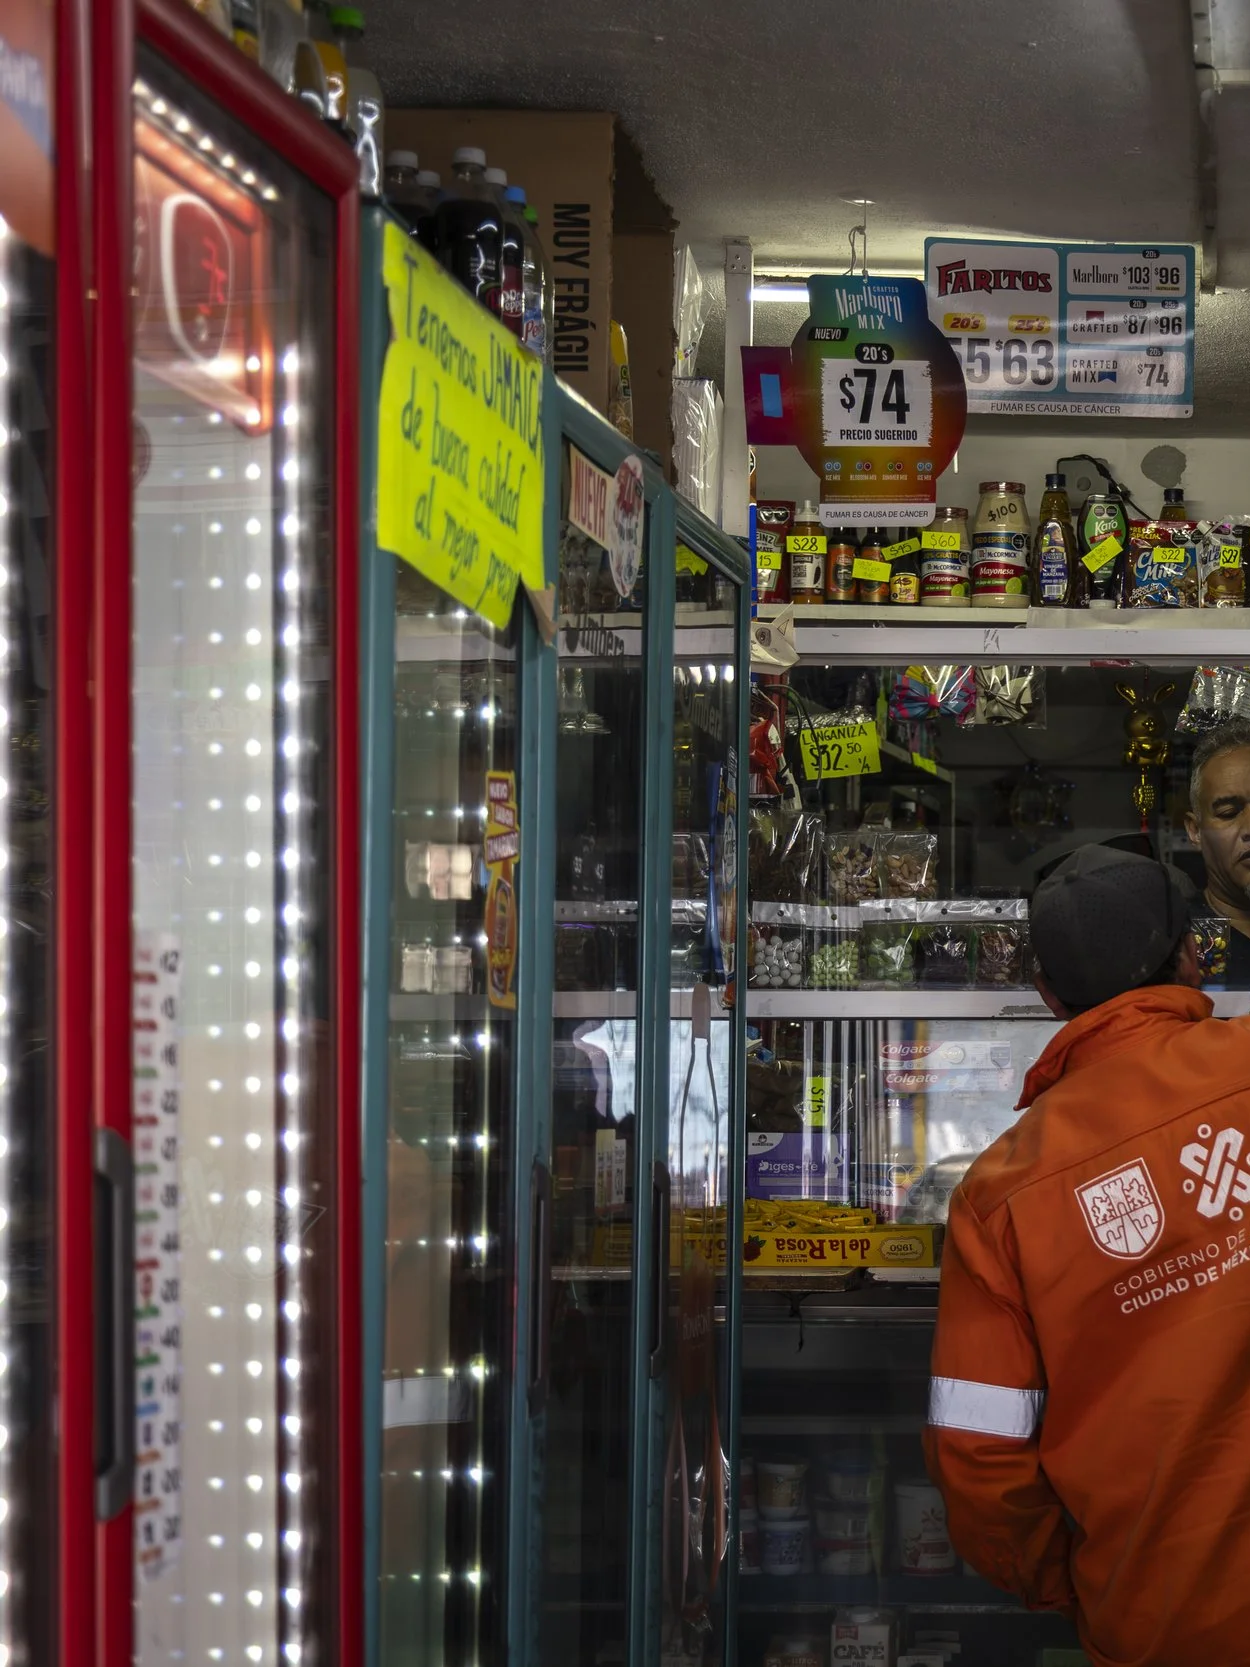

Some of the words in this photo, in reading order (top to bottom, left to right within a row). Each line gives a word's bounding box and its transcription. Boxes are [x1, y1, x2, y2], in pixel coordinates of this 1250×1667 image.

[553, 203, 591, 267] MUY
[936, 259, 1053, 298] FARITOS
[1072, 264, 1119, 284] Marlboro
[1122, 266, 1150, 284] $103
[1154, 266, 1180, 285] $96
[872, 285, 899, 293] CRAFTED
[835, 286, 904, 323] Marlboro
[402, 252, 478, 396] Tenemos
[553, 276, 594, 375] FRÁGIL
[857, 314, 886, 330] MIX
[1072, 323, 1119, 334] CRAFTED
[1123, 314, 1147, 335] $87
[1154, 316, 1182, 336] $96
[814, 327, 842, 341] NUEVO
[995, 338, 1054, 386] $63
[1072, 359, 1118, 370] CRAFTED
[1072, 371, 1098, 384] MIX
[1137, 363, 1170, 387] $74
[839, 368, 911, 425] $74
[990, 402, 1023, 412] FUMAR
[1025, 402, 1037, 412] ES
[1037, 402, 1068, 414] CAUSA
[1069, 403, 1083, 414] DE
[1084, 403, 1121, 414] CÁNCER
[401, 366, 423, 451] de
[430, 383, 471, 495] buena
[840, 429, 872, 441] PRECIO
[874, 429, 918, 441] SUGERIDO
[414, 474, 436, 541] al
[573, 456, 608, 541] NUEVA
[825, 511, 850, 519] FUMAR
[863, 510, 887, 518] CAUSA
[888, 510, 899, 518] DE
[899, 509, 929, 518] CÁNCER
[987, 502, 1018, 523] $100
[1094, 521, 1118, 537] Karo
[793, 537, 819, 552] $28
[929, 535, 956, 548] $60
[1161, 550, 1181, 561] $22
[929, 575, 959, 583] Mayonesa
[979, 567, 1015, 576] Mayonesa
[801, 726, 868, 747] LONGANIZA
[881, 1043, 933, 1055] Colgate
[885, 1072, 938, 1085] Colgate
[775, 1238, 827, 1261] Rosa
[1113, 1243, 1220, 1297] GOBIERNO
[1226, 1228, 1247, 1250] DE
[1120, 1276, 1191, 1315] CIUDAD
[1193, 1265, 1219, 1287] DE
[834, 1641, 886, 1661] CAFÉ
